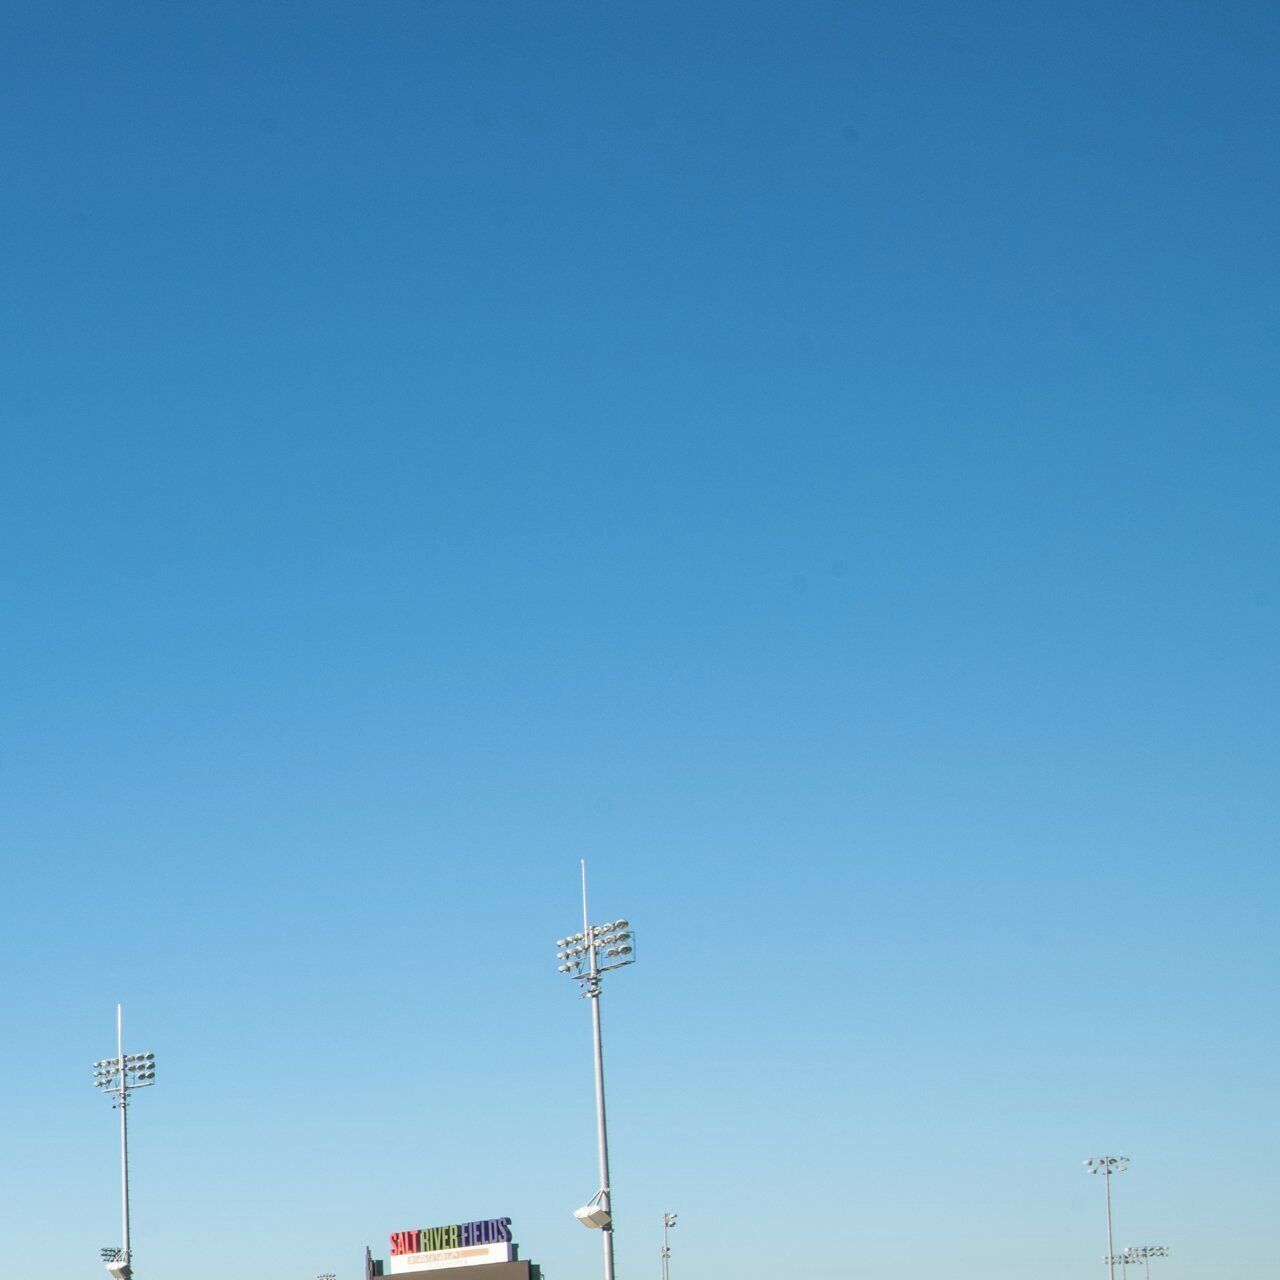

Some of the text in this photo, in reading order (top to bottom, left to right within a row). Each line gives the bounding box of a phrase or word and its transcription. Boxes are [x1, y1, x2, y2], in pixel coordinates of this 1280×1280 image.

[389, 1216, 513, 1256] SALT RIVER FIELDS
